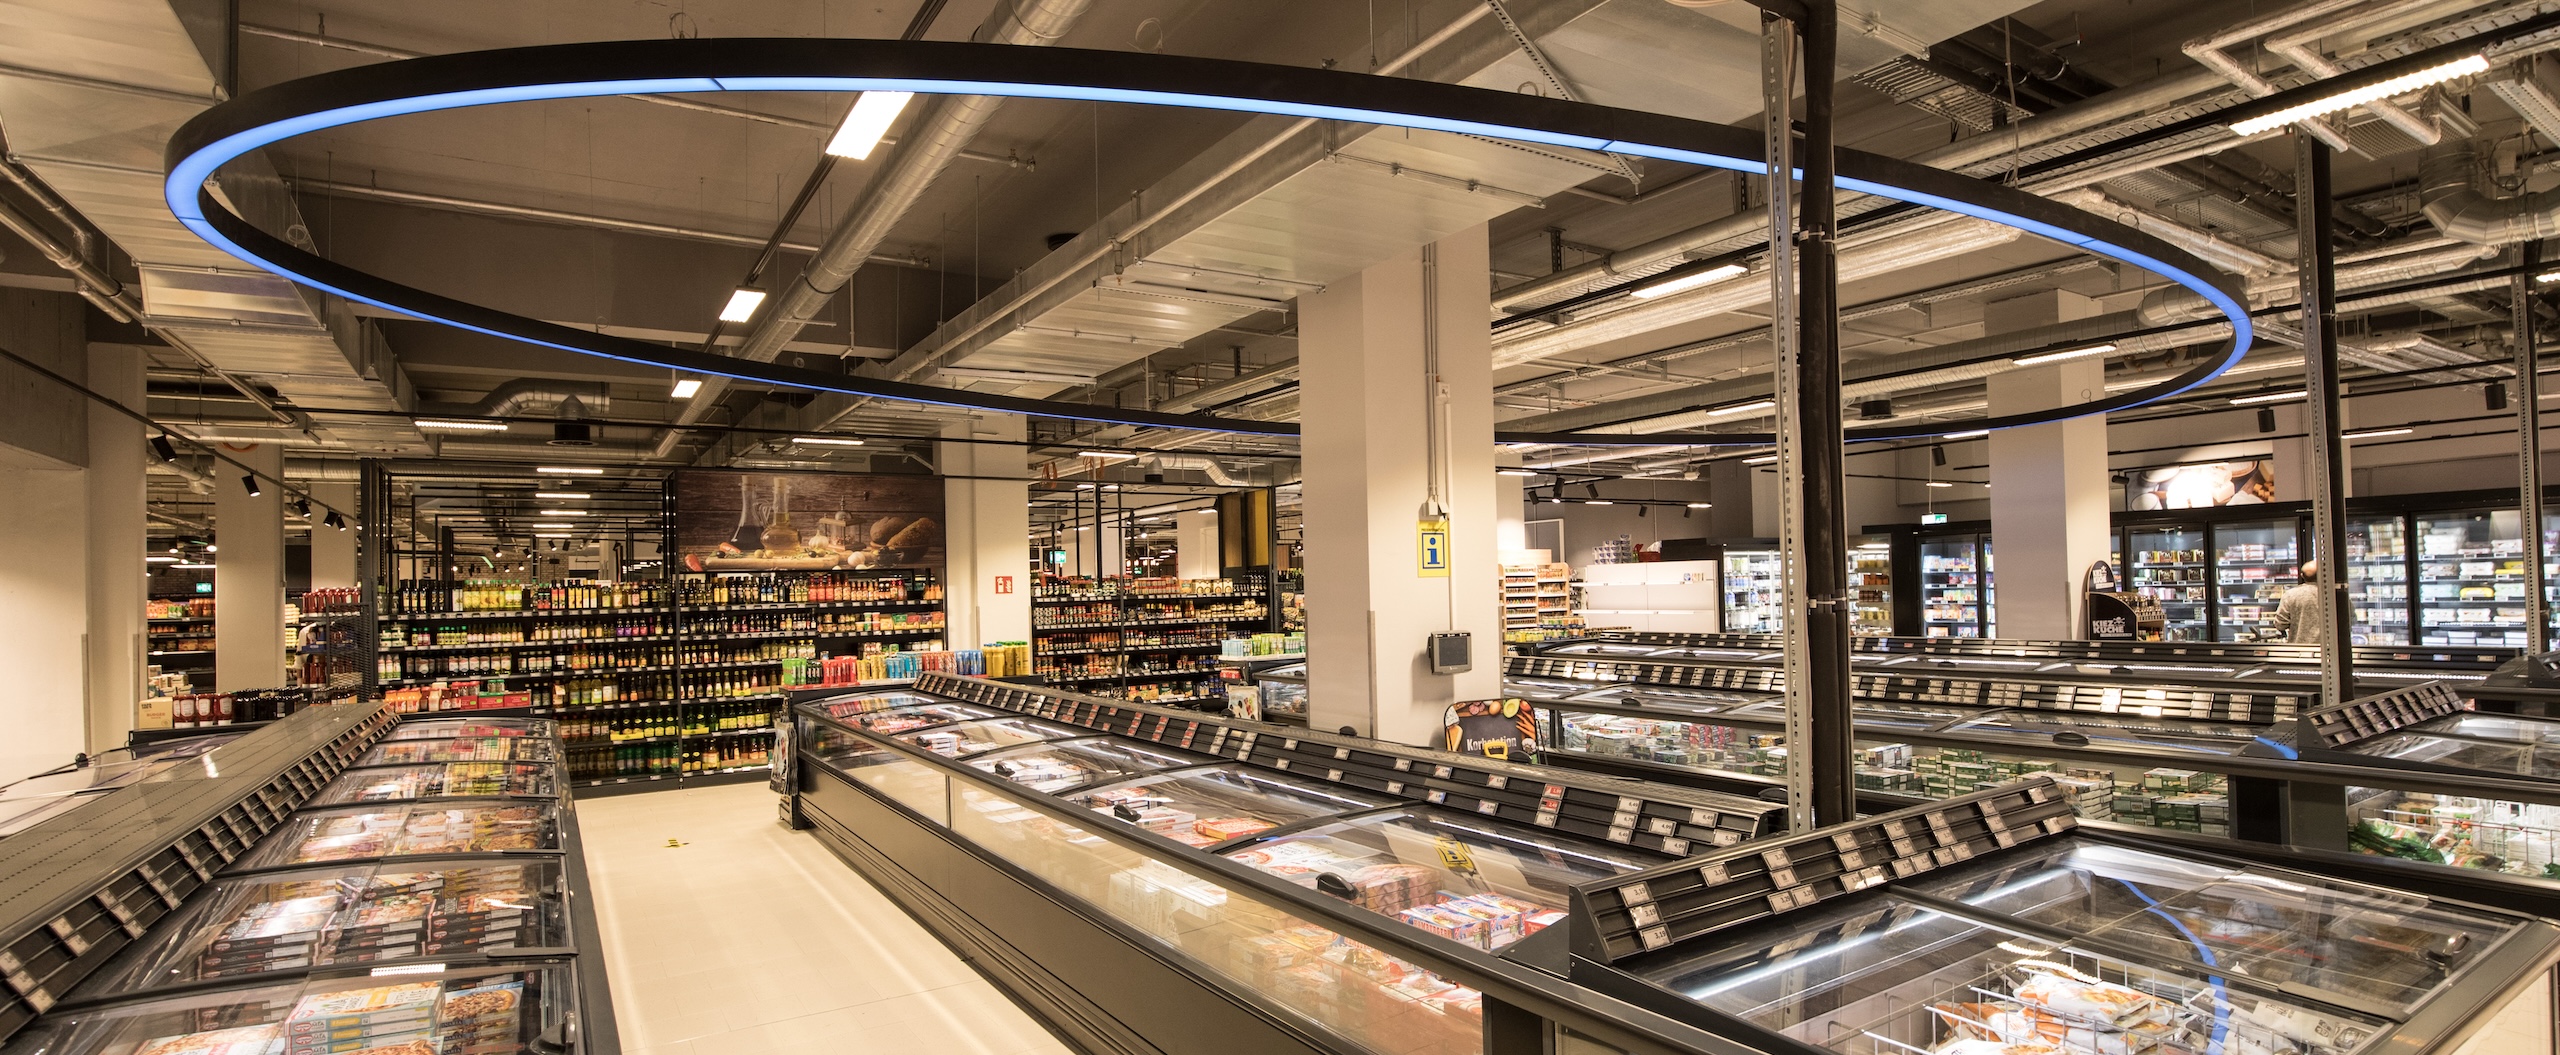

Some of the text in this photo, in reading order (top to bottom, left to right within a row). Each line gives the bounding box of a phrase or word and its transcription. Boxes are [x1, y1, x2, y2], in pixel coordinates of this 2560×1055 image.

[1715, 868, 1725, 876] 3,19
[1634, 887, 1646, 896] 3,19
[1644, 908, 1656, 917] 3,19
[1655, 930, 1666, 939] 3,19
